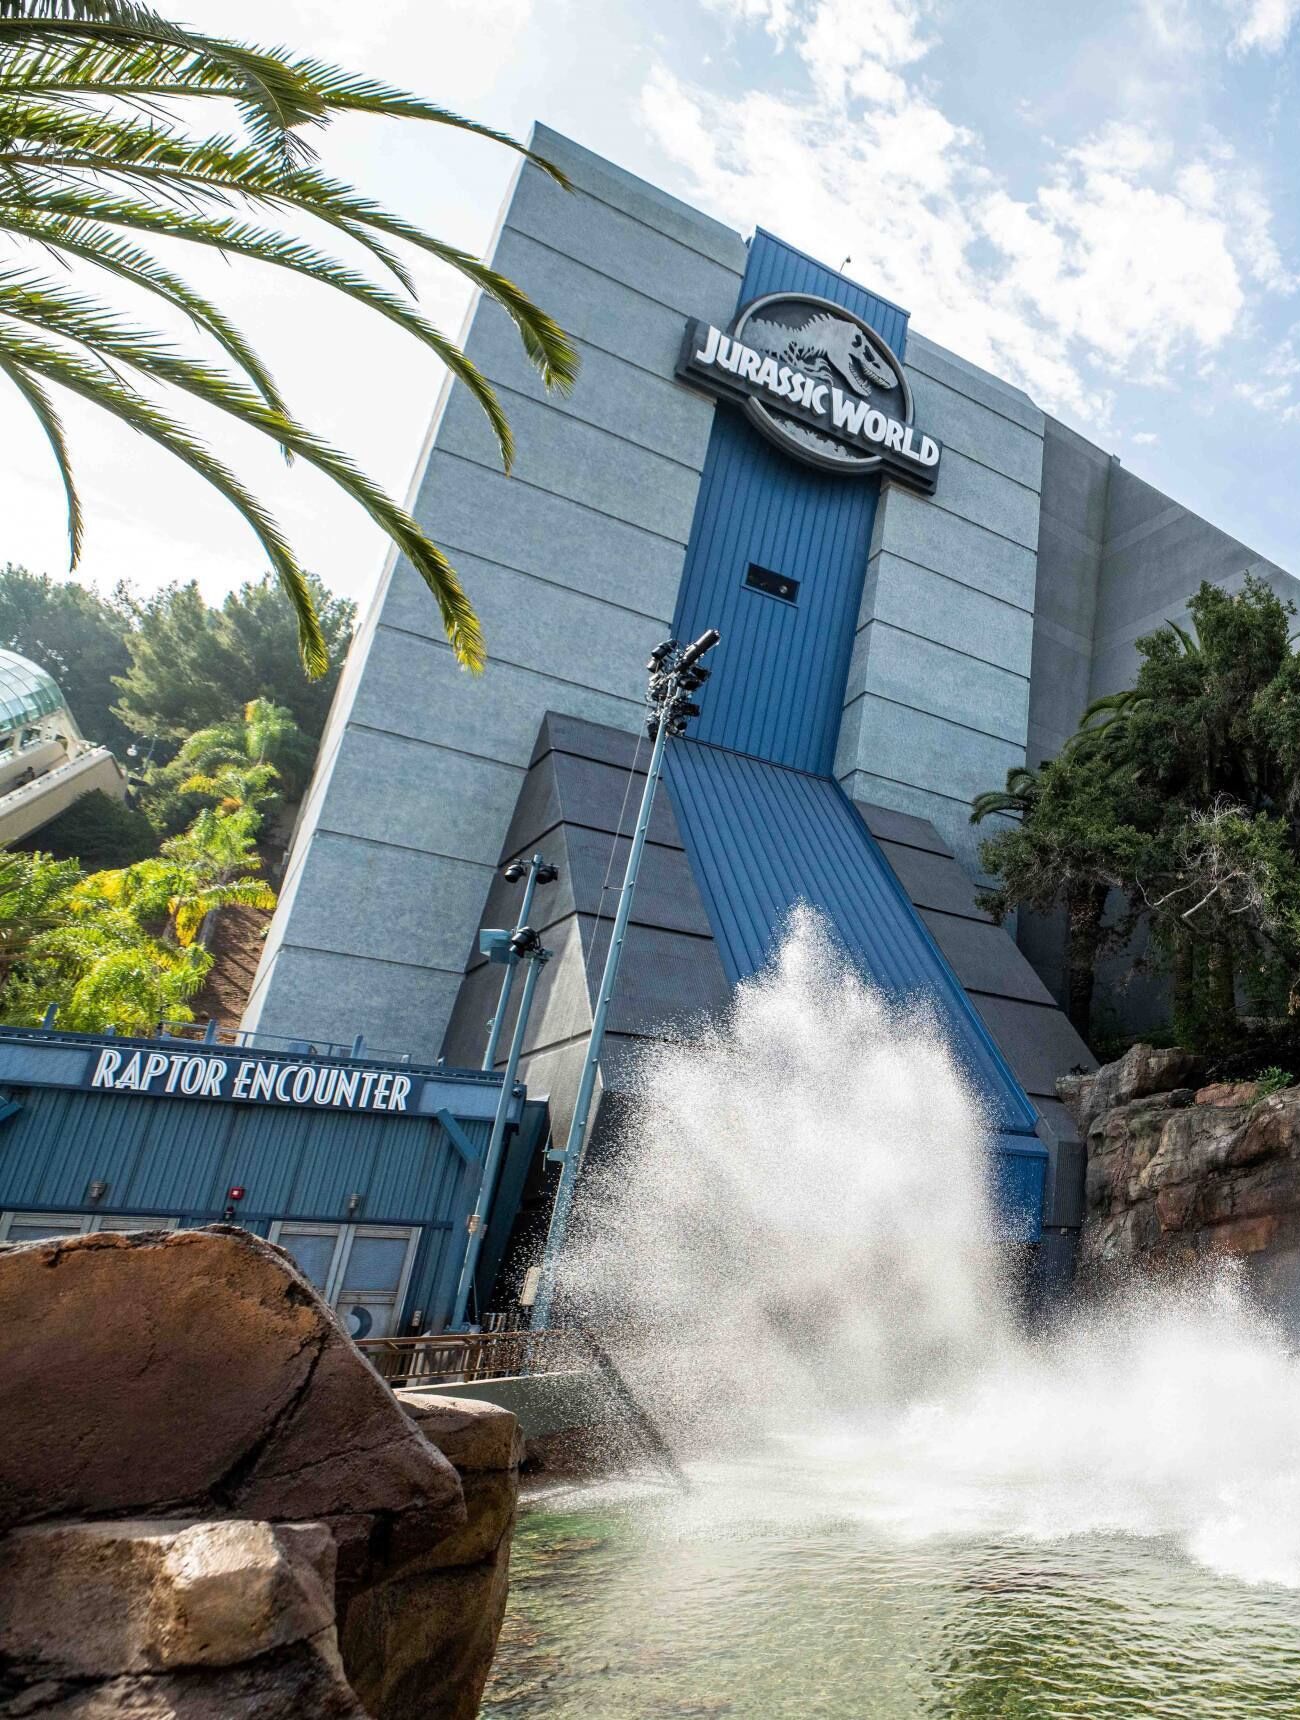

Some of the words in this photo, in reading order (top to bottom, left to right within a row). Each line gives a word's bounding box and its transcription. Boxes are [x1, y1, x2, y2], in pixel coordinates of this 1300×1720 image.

[696, 325, 829, 416] JURASSIC
[832, 387, 940, 466] WORLD
[92, 1049, 227, 1097] RAPTOR
[232, 1062, 412, 1111] ENCOUNTER
